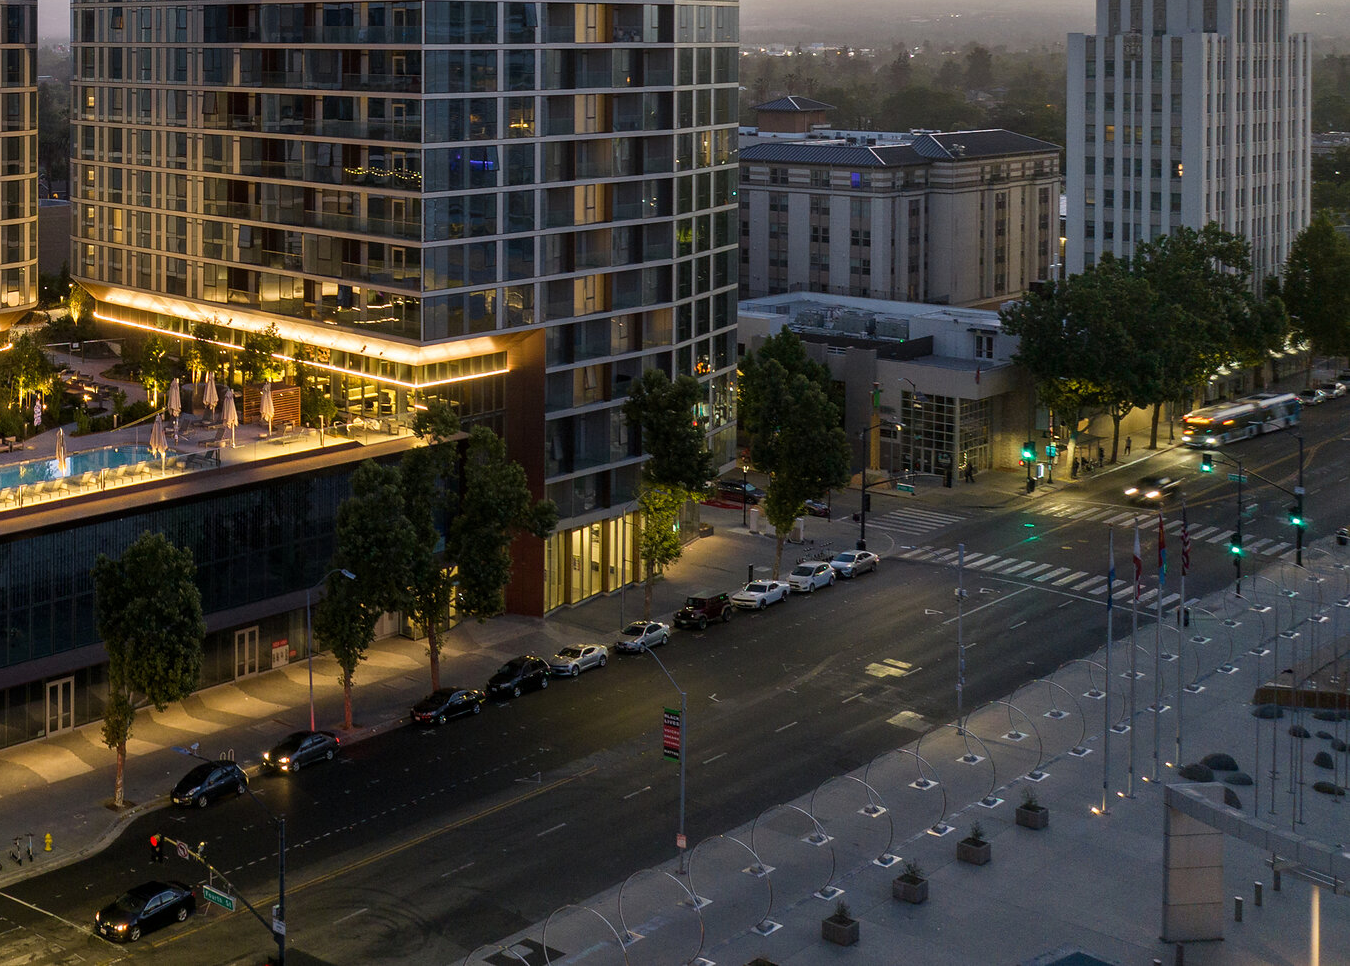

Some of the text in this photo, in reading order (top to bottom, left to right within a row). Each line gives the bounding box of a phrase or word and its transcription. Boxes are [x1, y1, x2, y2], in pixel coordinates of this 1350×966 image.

[664, 713, 680, 721] BLACK
[205, 890, 232, 908] Fourth St
